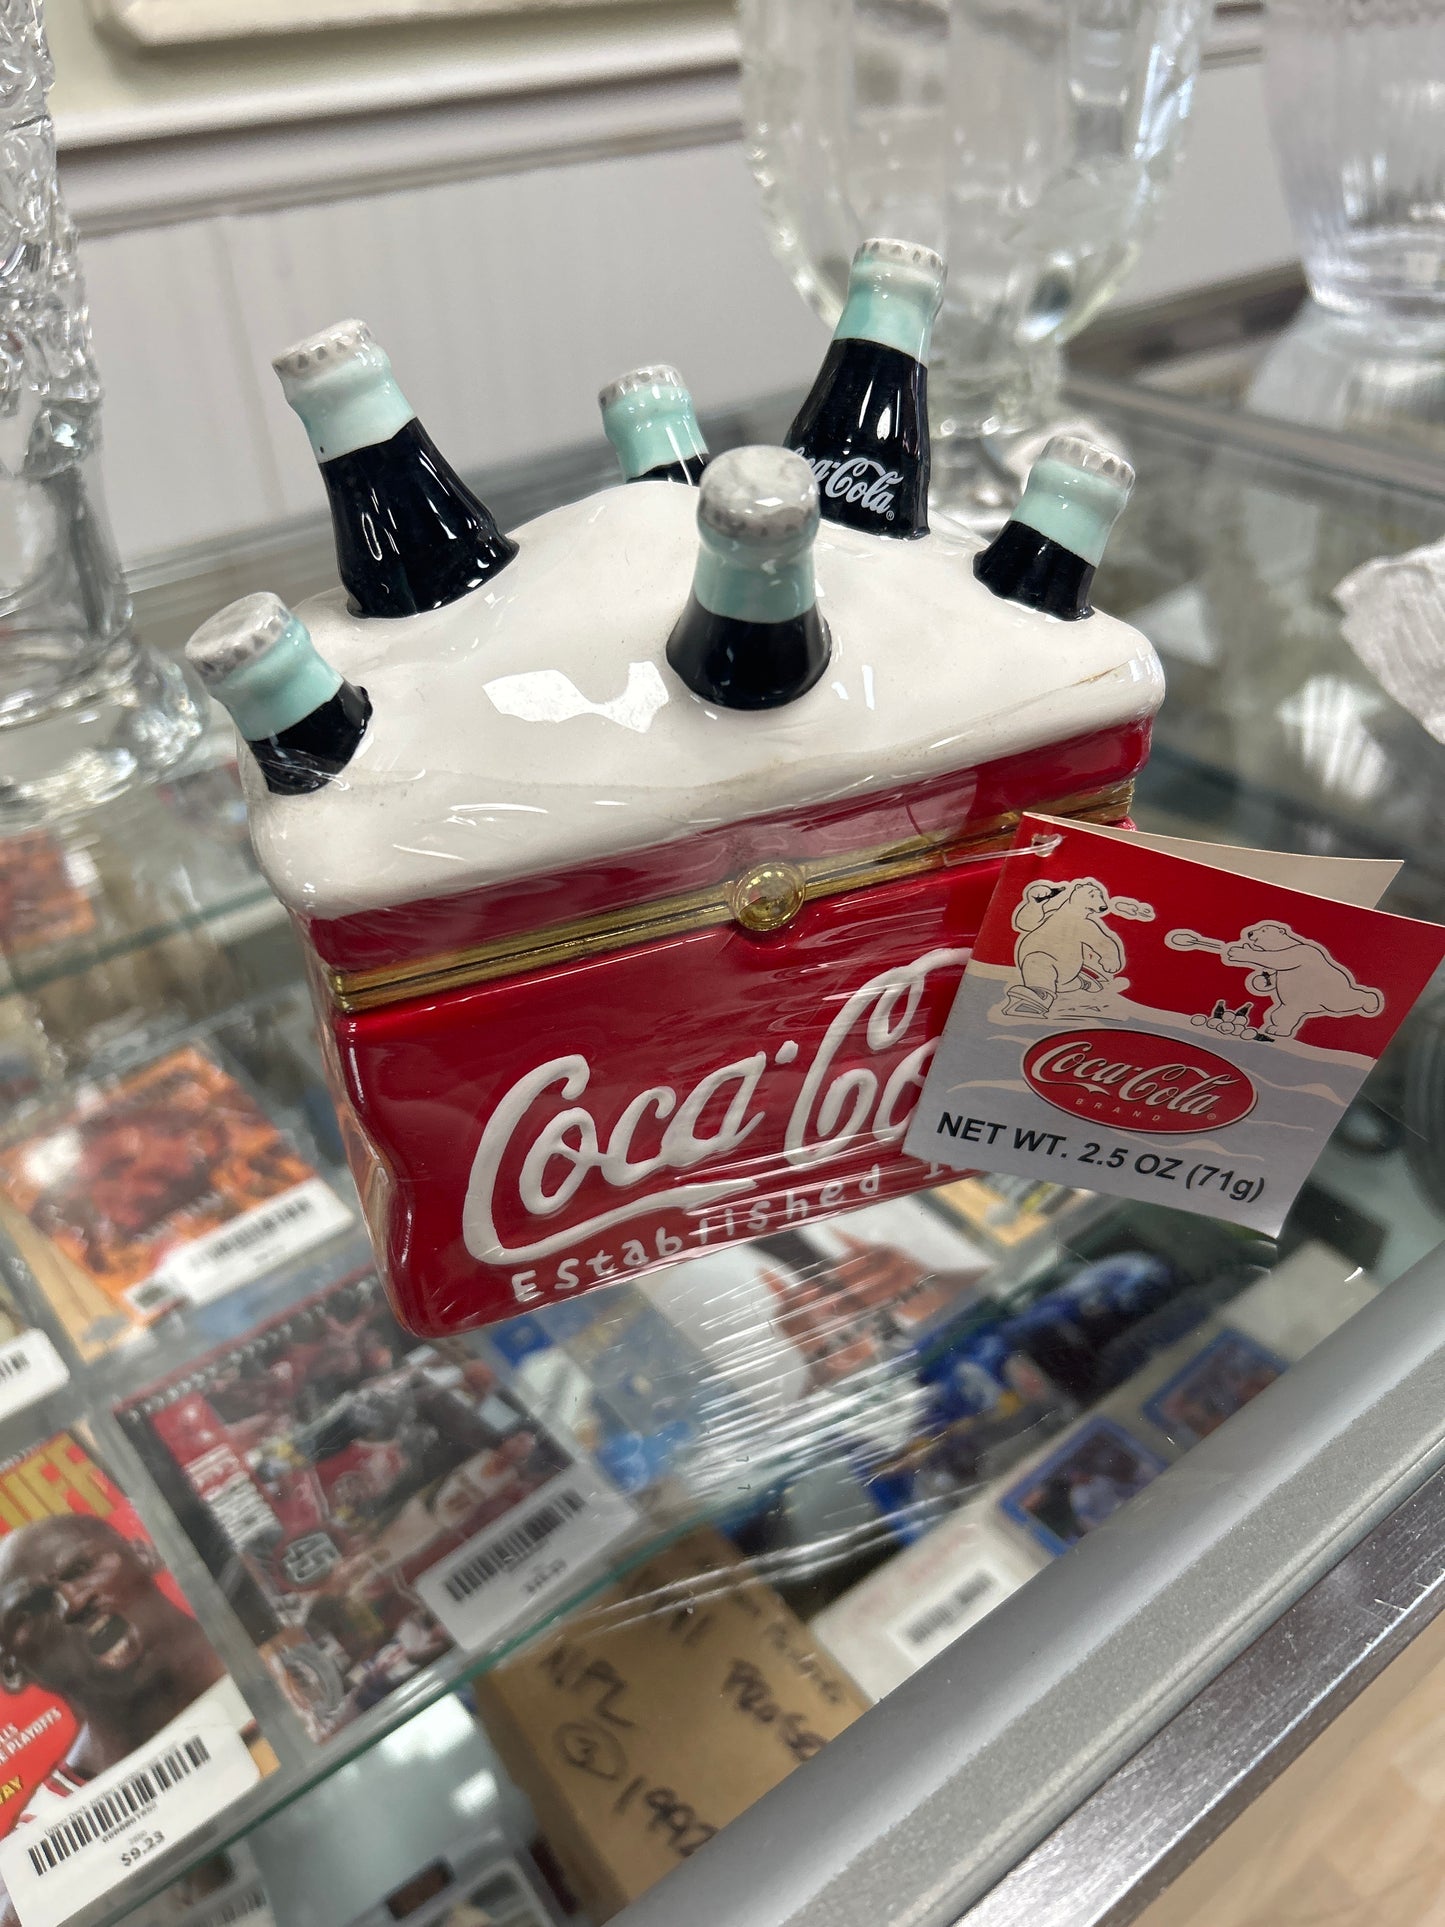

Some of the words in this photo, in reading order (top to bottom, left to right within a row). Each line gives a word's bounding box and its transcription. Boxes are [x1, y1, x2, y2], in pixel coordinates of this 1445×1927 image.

[1031, 1041, 1240, 1115] Coca-Cola
[1075, 1098, 1161, 1122] BRAND
[936, 1111, 1006, 1145] NET
[1013, 1128, 1067, 1159] WT.
[1077, 1142, 1128, 1169] 2.5
[1134, 1153, 1183, 1181] OZ
[1185, 1163, 1265, 1203] (71g)
[6, 1706, 62, 1756] PLAYOFFS
[120, 1829, 166, 1868] $9.23
